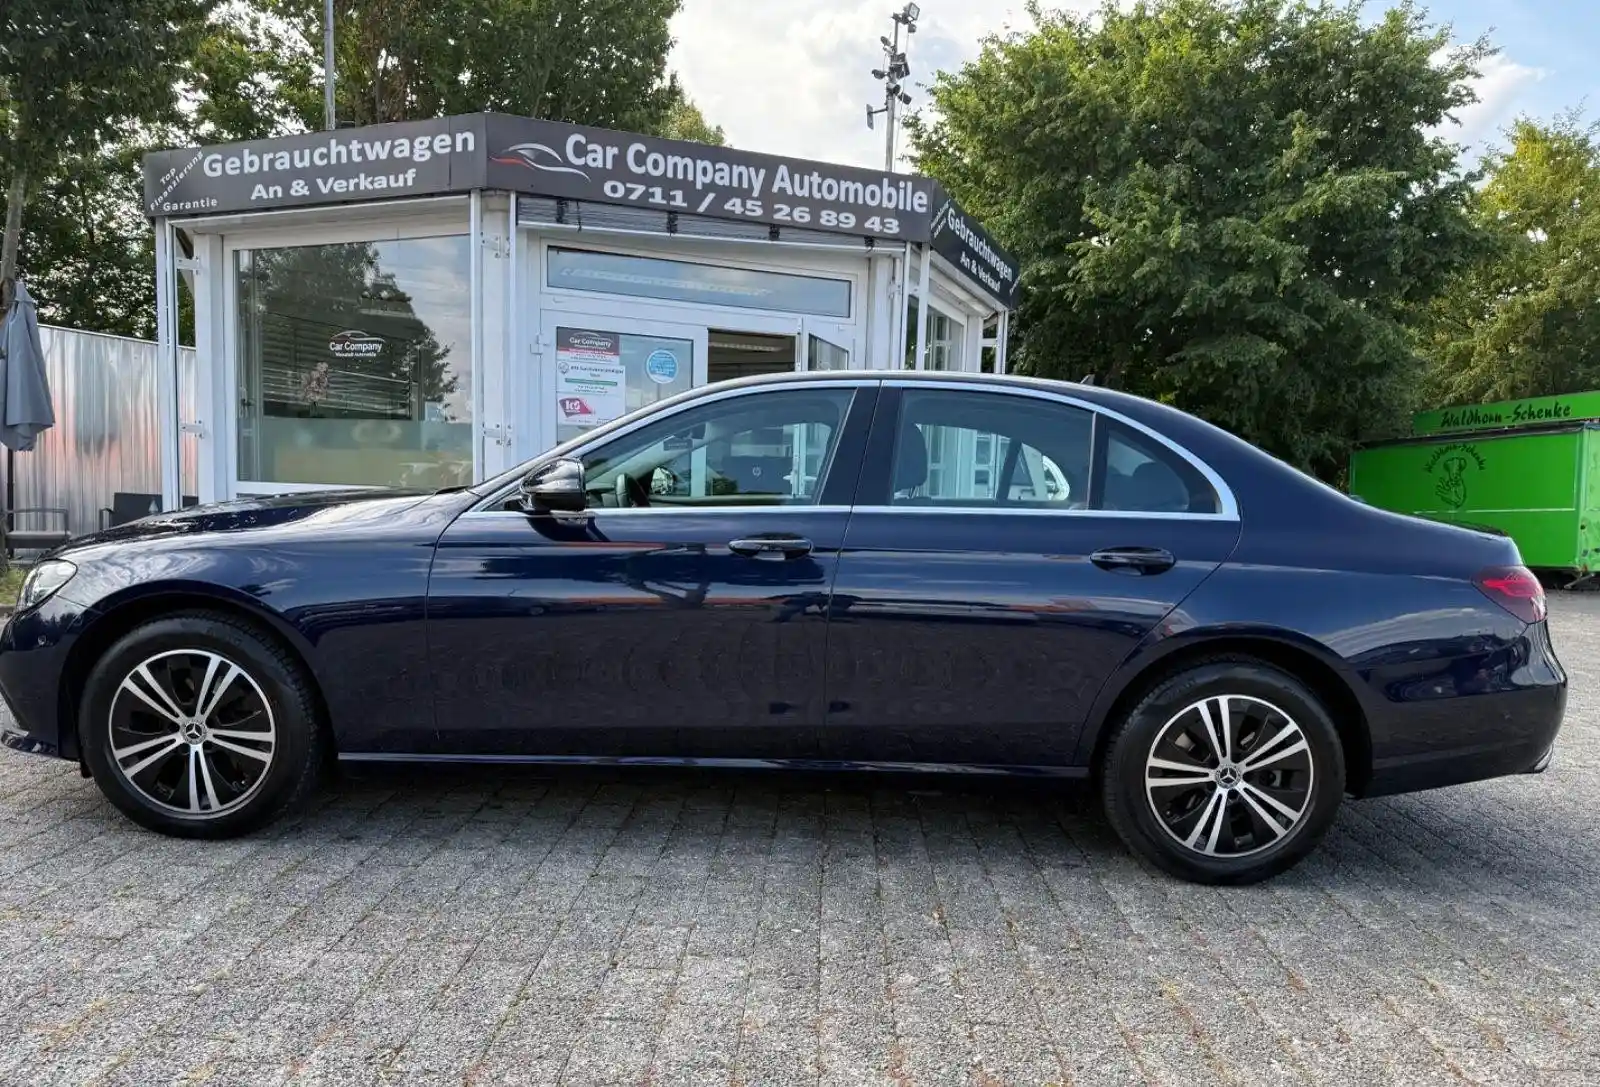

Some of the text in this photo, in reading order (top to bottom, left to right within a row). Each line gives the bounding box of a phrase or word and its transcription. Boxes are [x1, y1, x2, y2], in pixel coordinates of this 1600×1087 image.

[203, 130, 475, 178] Gebrauchtwagen
[565, 132, 929, 214] Car Company Automobile
[150, 151, 203, 211] Finanzierung
[160, 167, 176, 185] Top
[251, 168, 417, 200] An & Verkauf
[162, 196, 218, 212] Garantie
[603, 180, 688, 208] 0711
[723, 197, 764, 217] 45
[773, 204, 812, 224] 26
[819, 211, 856, 229] 89
[863, 216, 900, 234] 43
[948, 207, 1013, 282] Gebrauchtwagen
[960, 251, 970, 270] An
[329, 341, 383, 353] Car Company
